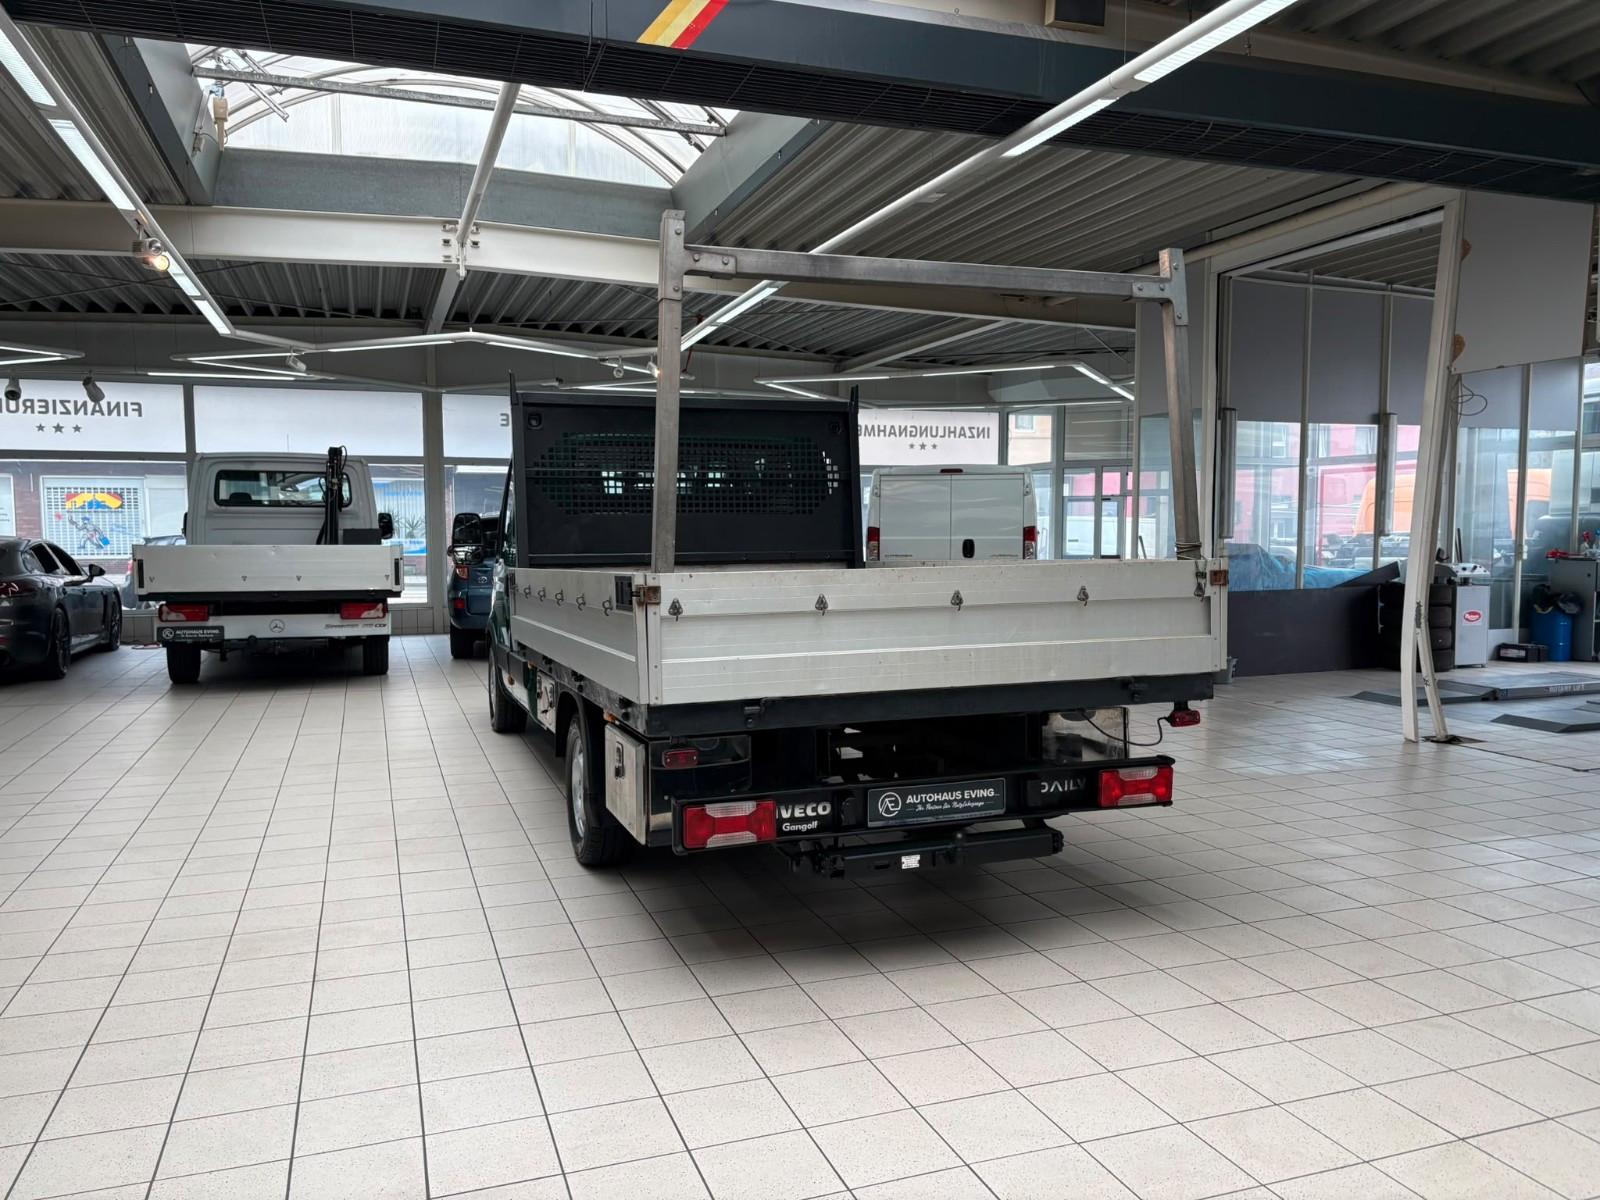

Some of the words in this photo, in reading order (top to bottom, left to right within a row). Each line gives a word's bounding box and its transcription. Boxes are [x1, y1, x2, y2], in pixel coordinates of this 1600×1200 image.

[906, 791, 962, 804] AUTOHAUS
[964, 788, 995, 799] EVING
[782, 820, 818, 832] Gangolf
